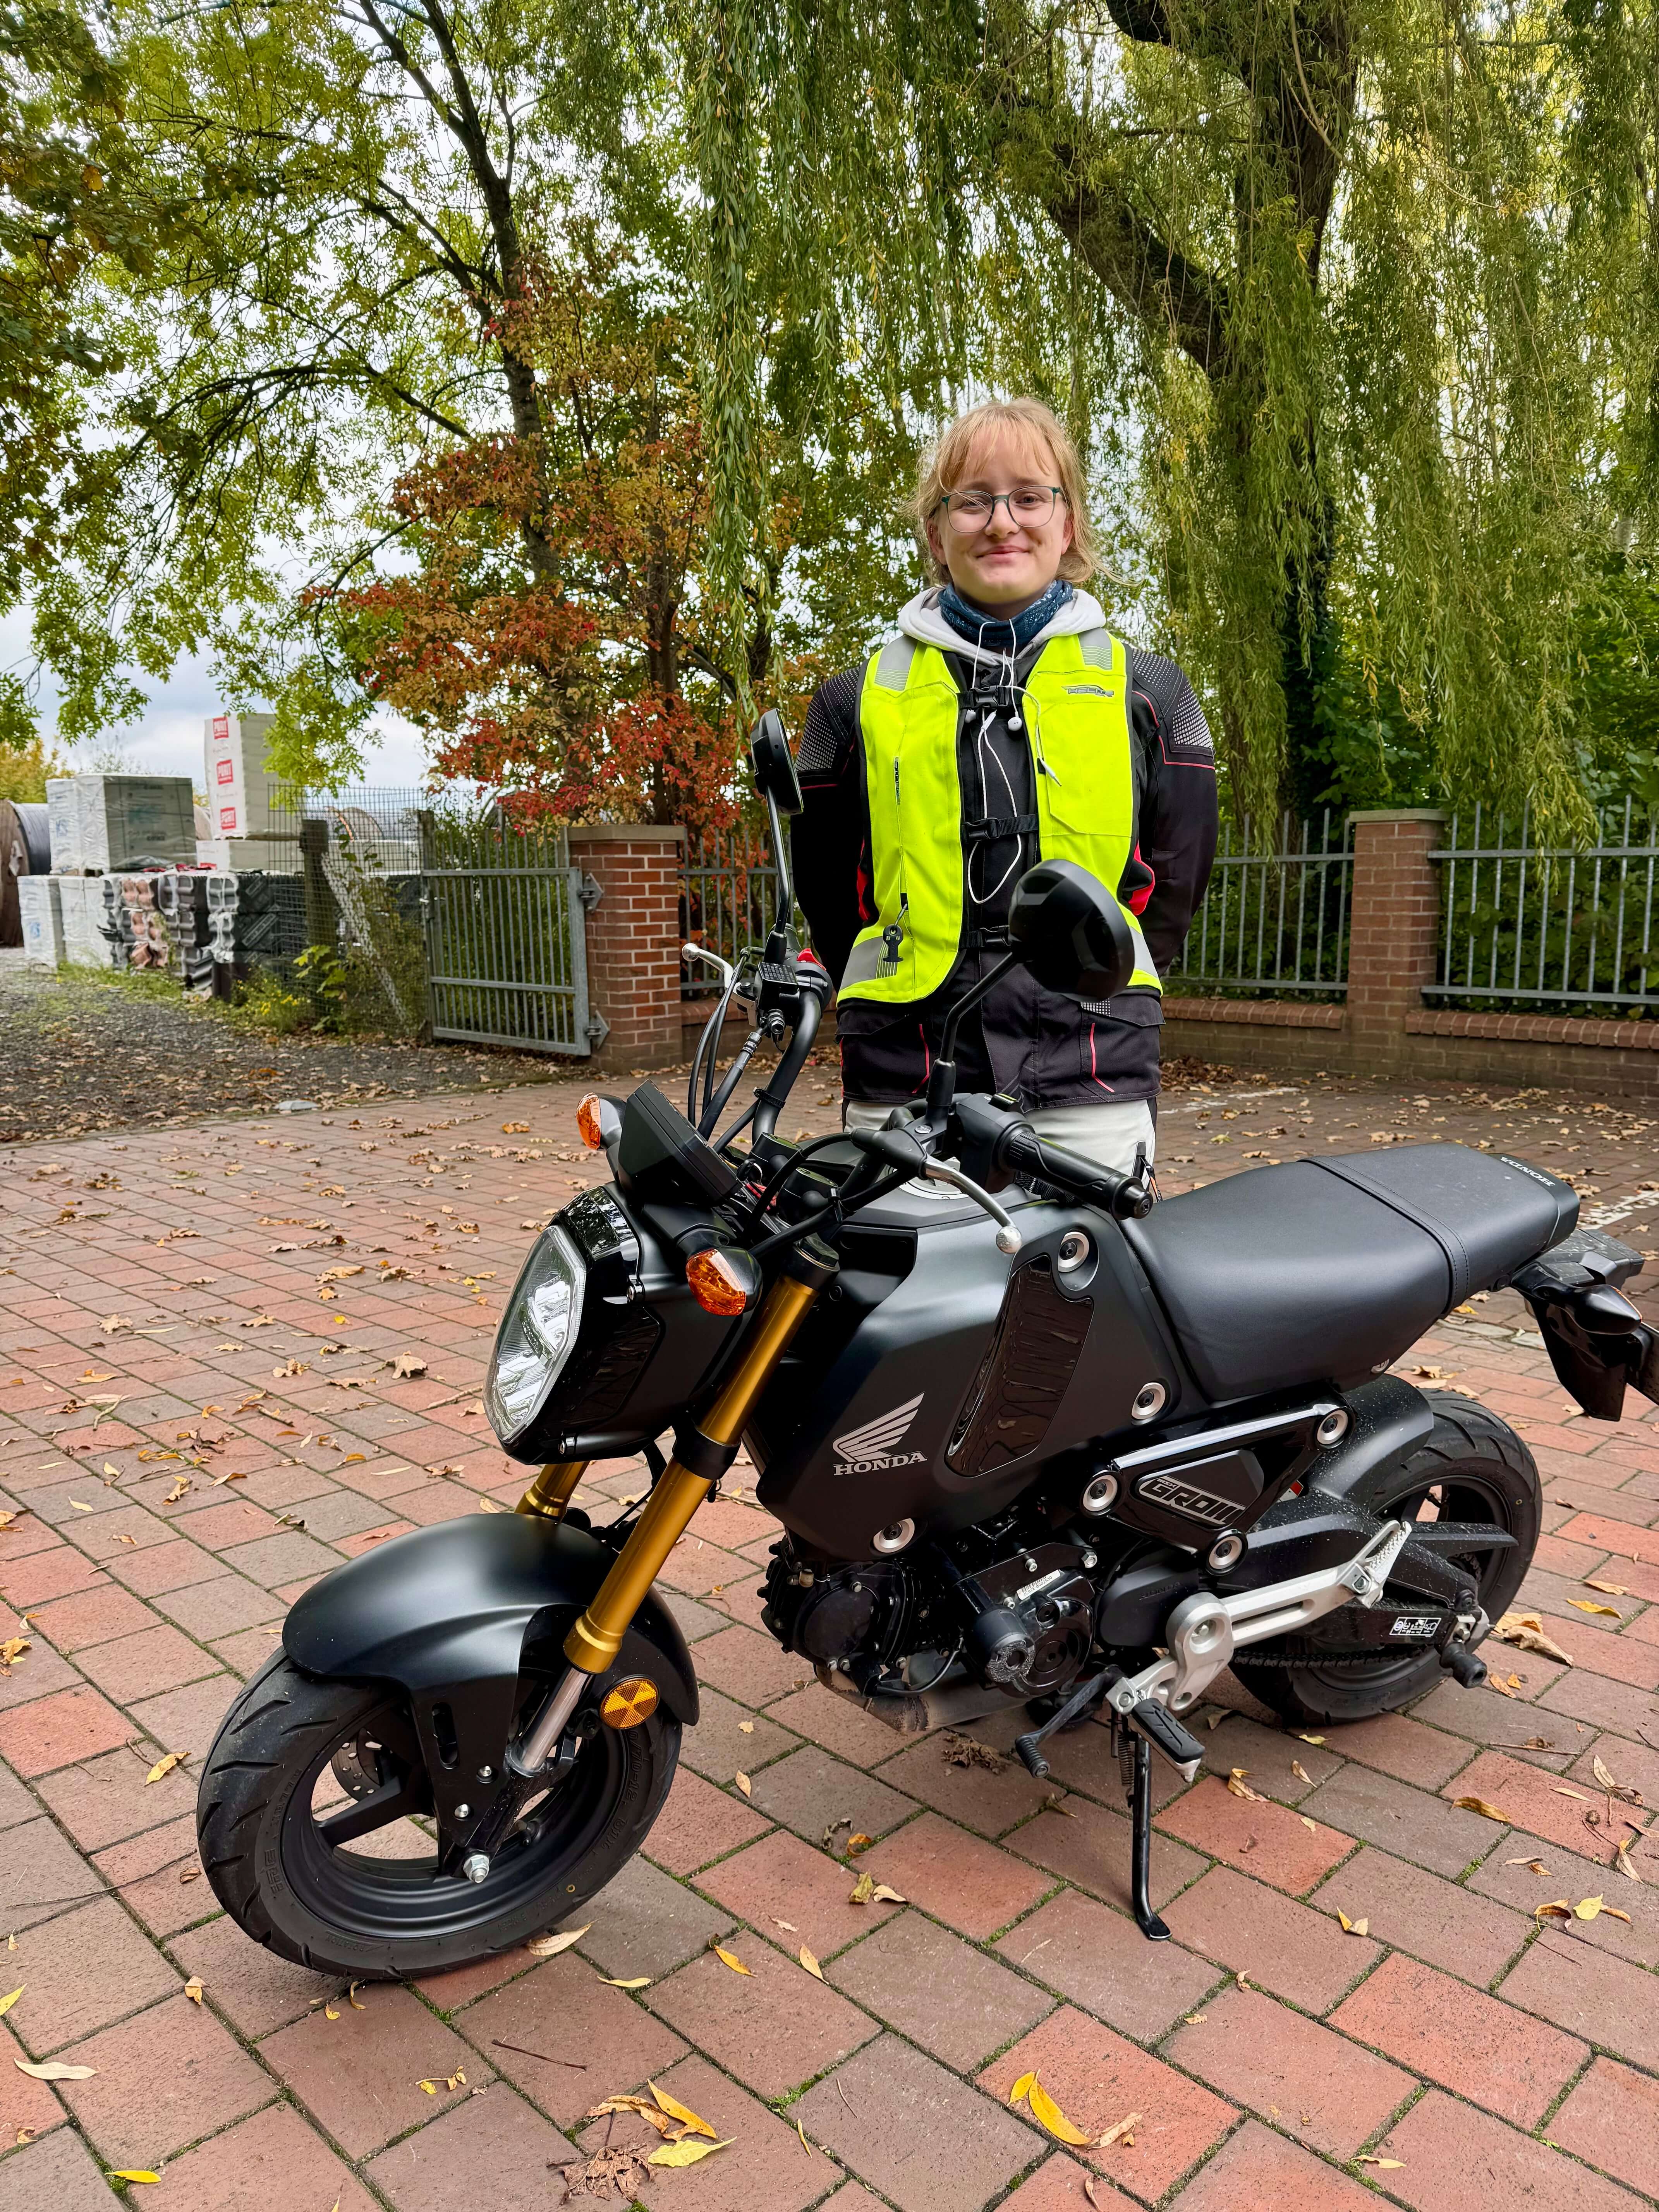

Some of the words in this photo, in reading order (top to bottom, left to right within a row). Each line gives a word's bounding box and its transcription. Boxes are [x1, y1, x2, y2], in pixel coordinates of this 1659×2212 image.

[1500, 1156, 1556, 1187] HONDA
[833, 1452, 927, 1476] HONDA
[1140, 1479, 1244, 1523] GROM
